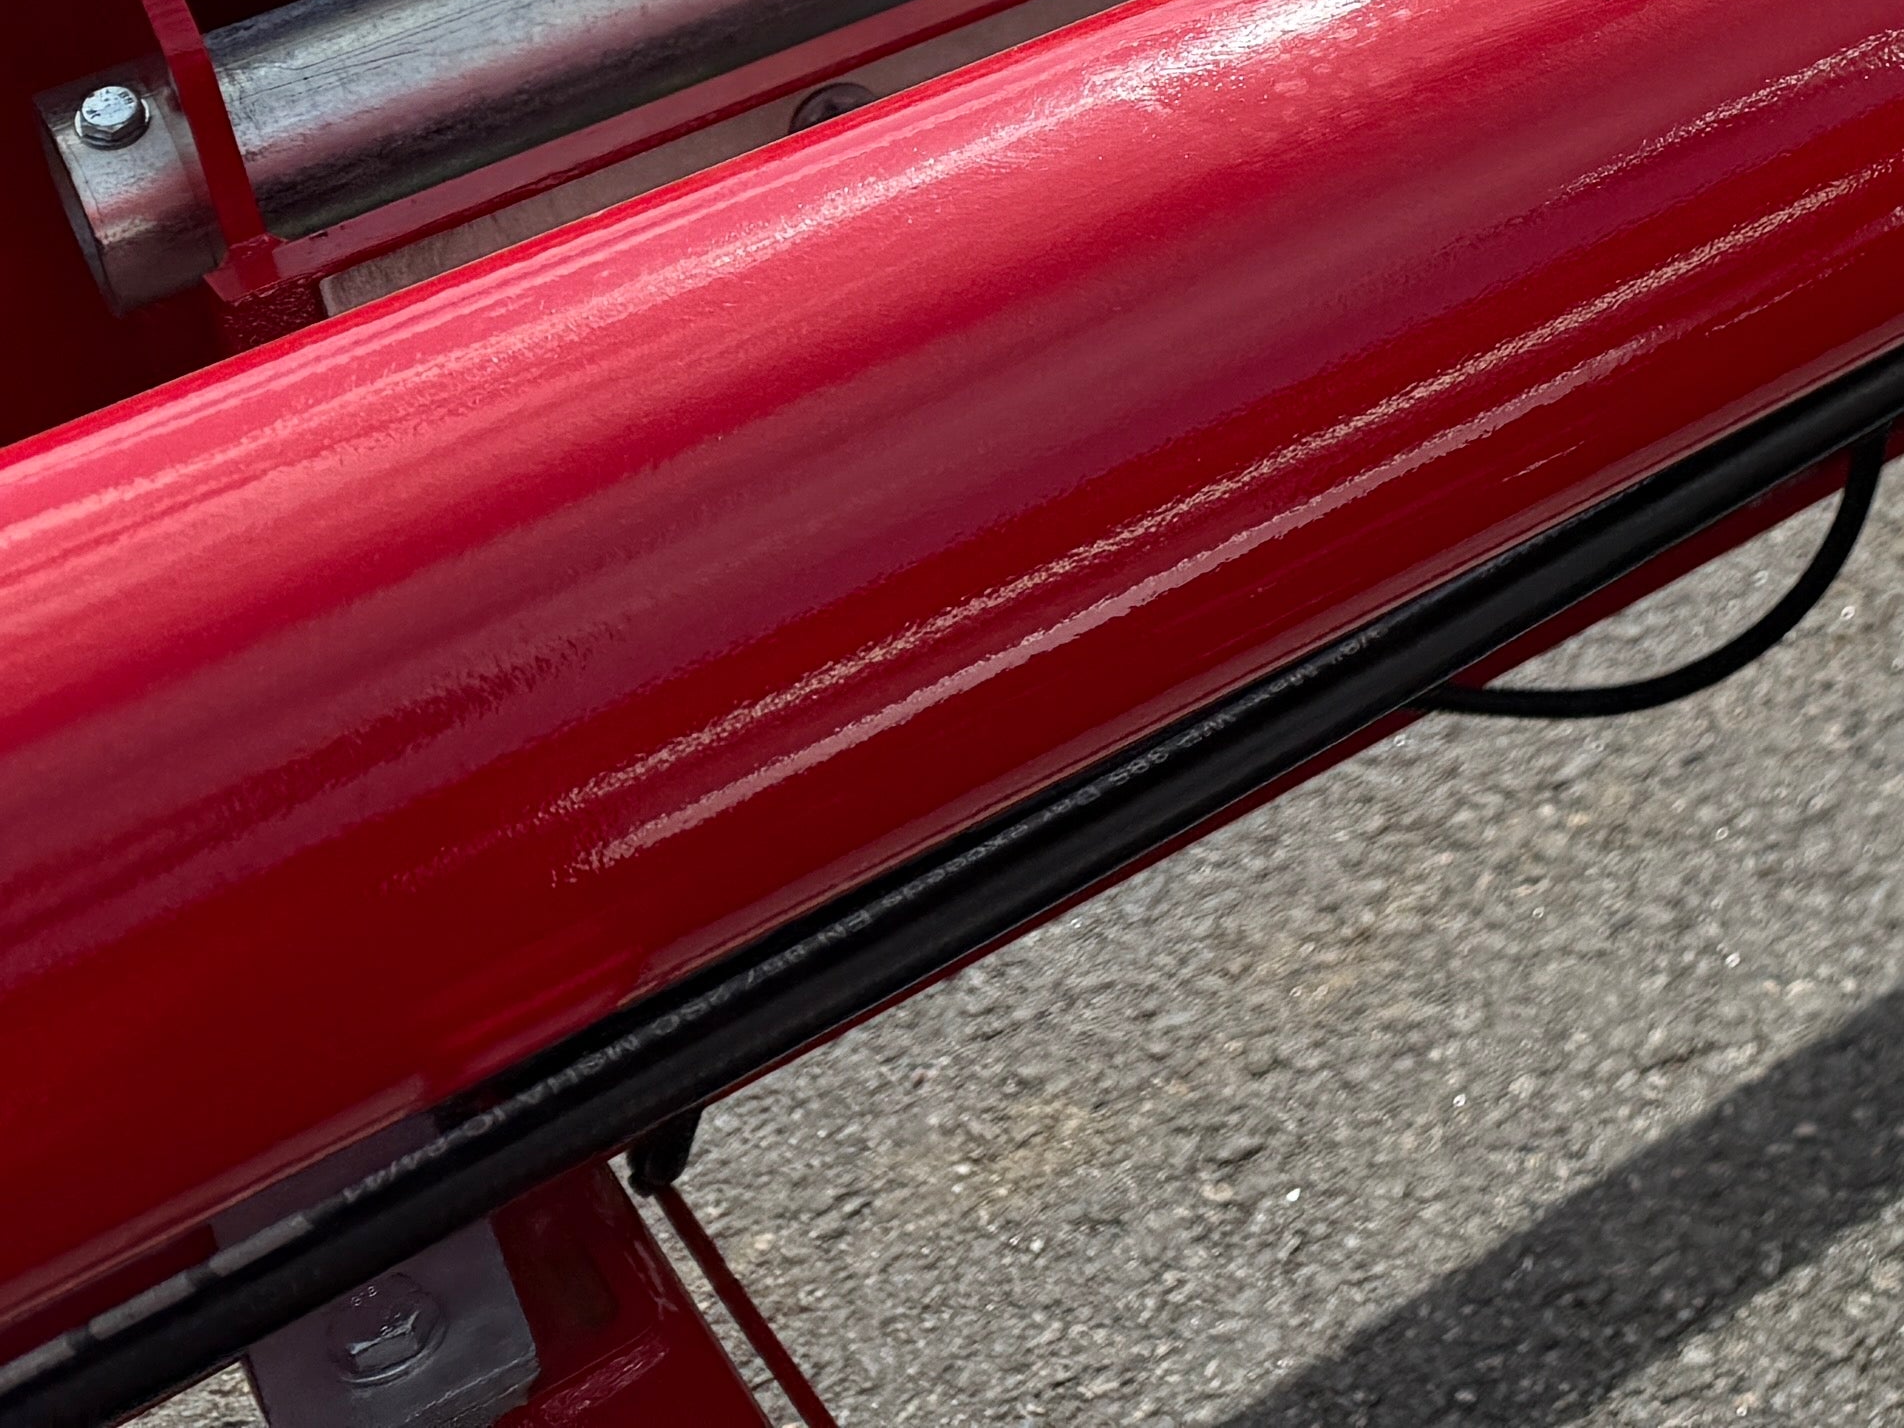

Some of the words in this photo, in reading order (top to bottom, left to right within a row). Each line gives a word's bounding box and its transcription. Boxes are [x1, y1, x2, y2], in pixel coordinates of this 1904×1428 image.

[1173, 706, 1236, 751] WP
[1106, 744, 1170, 787] 385
[1039, 782, 1101, 825] Bar
[879, 820, 1030, 911] exceeds
[815, 907, 873, 948] EN
[514, 1031, 643, 1111] MSHA
